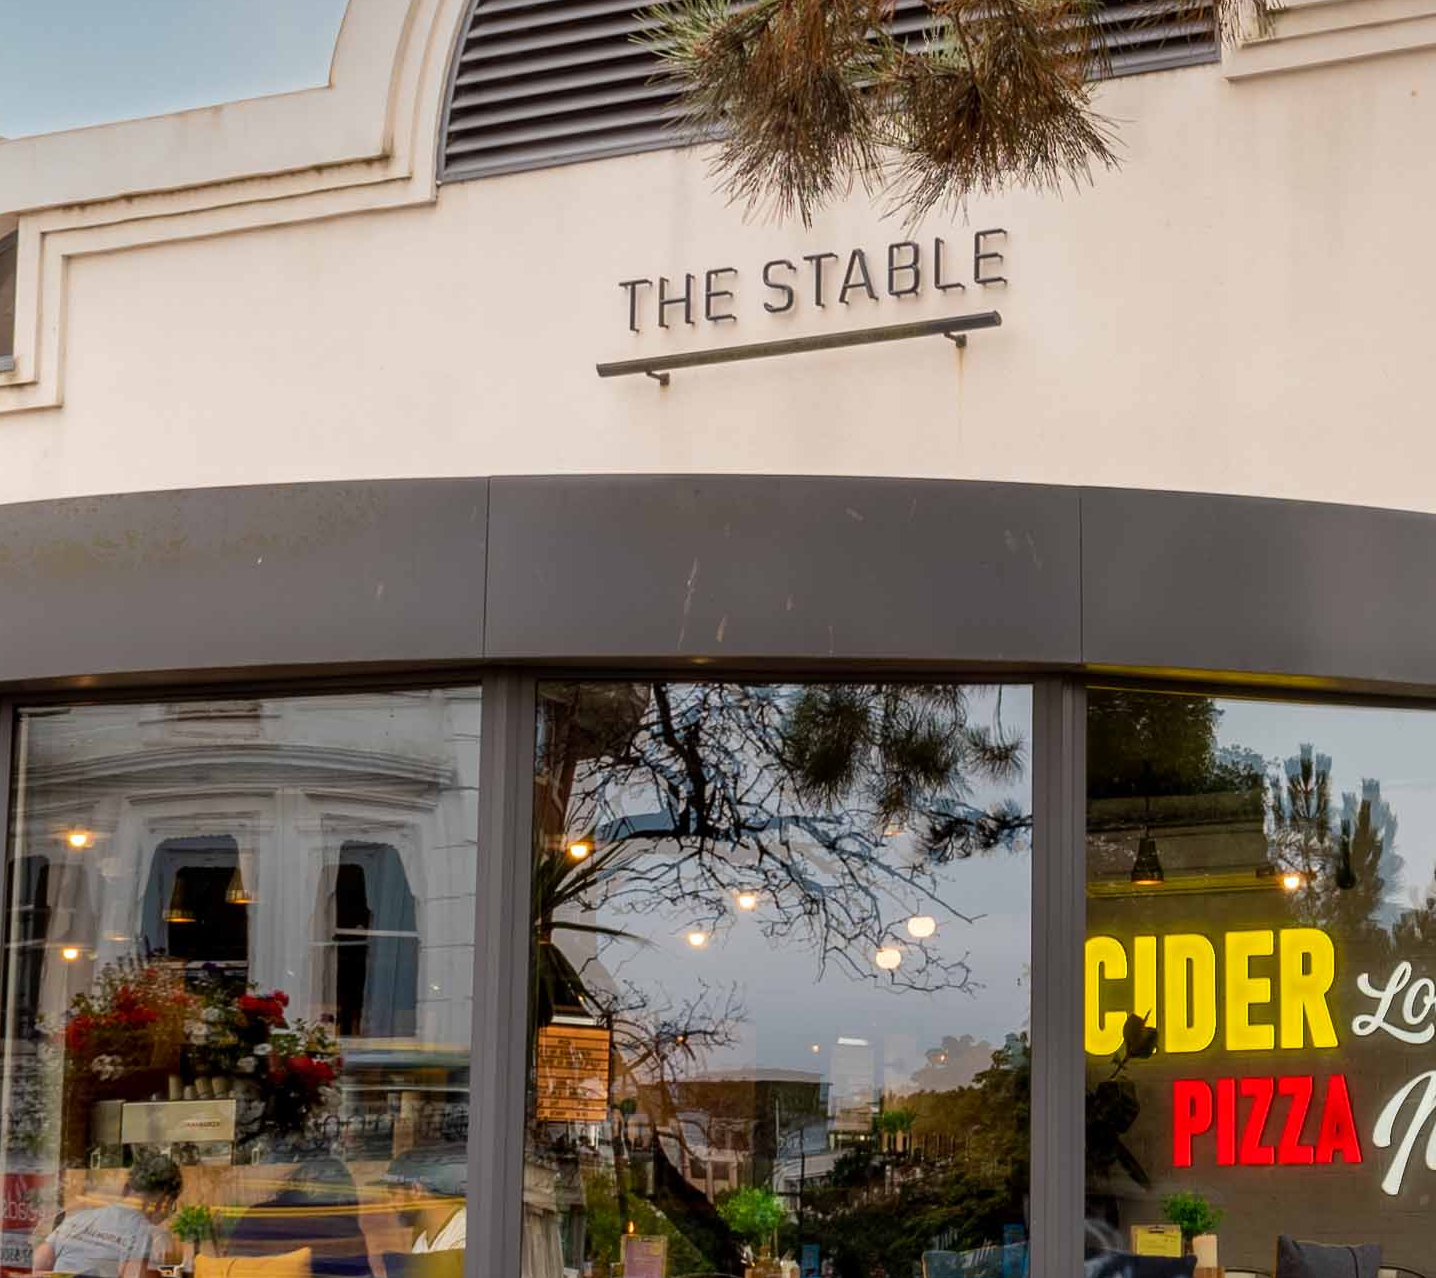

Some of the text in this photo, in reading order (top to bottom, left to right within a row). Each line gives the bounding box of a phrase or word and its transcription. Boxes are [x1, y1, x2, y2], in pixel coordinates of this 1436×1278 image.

[618, 228, 1009, 333] THE STABLE
[1084, 928, 1339, 1056] CIDER
[1172, 1074, 1363, 1167] PIZZA
